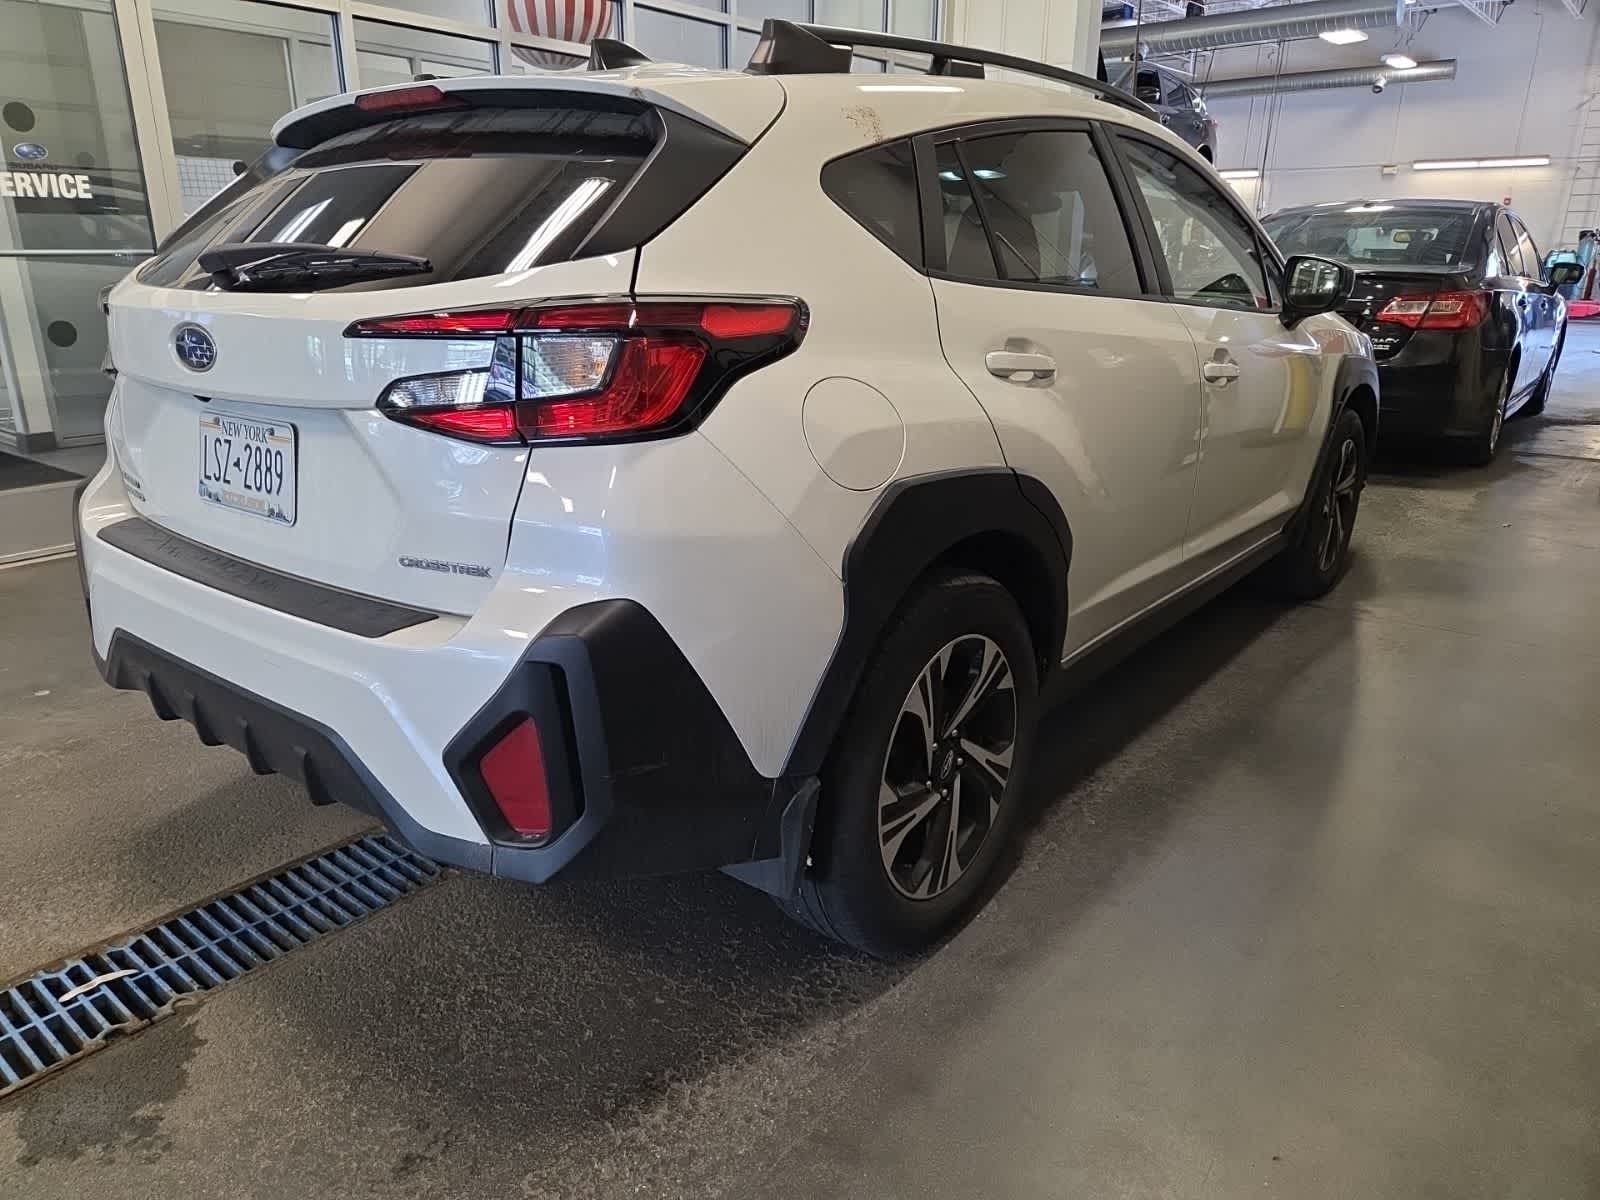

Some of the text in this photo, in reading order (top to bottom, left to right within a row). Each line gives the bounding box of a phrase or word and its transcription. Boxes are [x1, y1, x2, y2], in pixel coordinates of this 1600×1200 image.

[222, 421, 268, 444] NEW YORK
[399, 557, 492, 578] CROSSTREK
